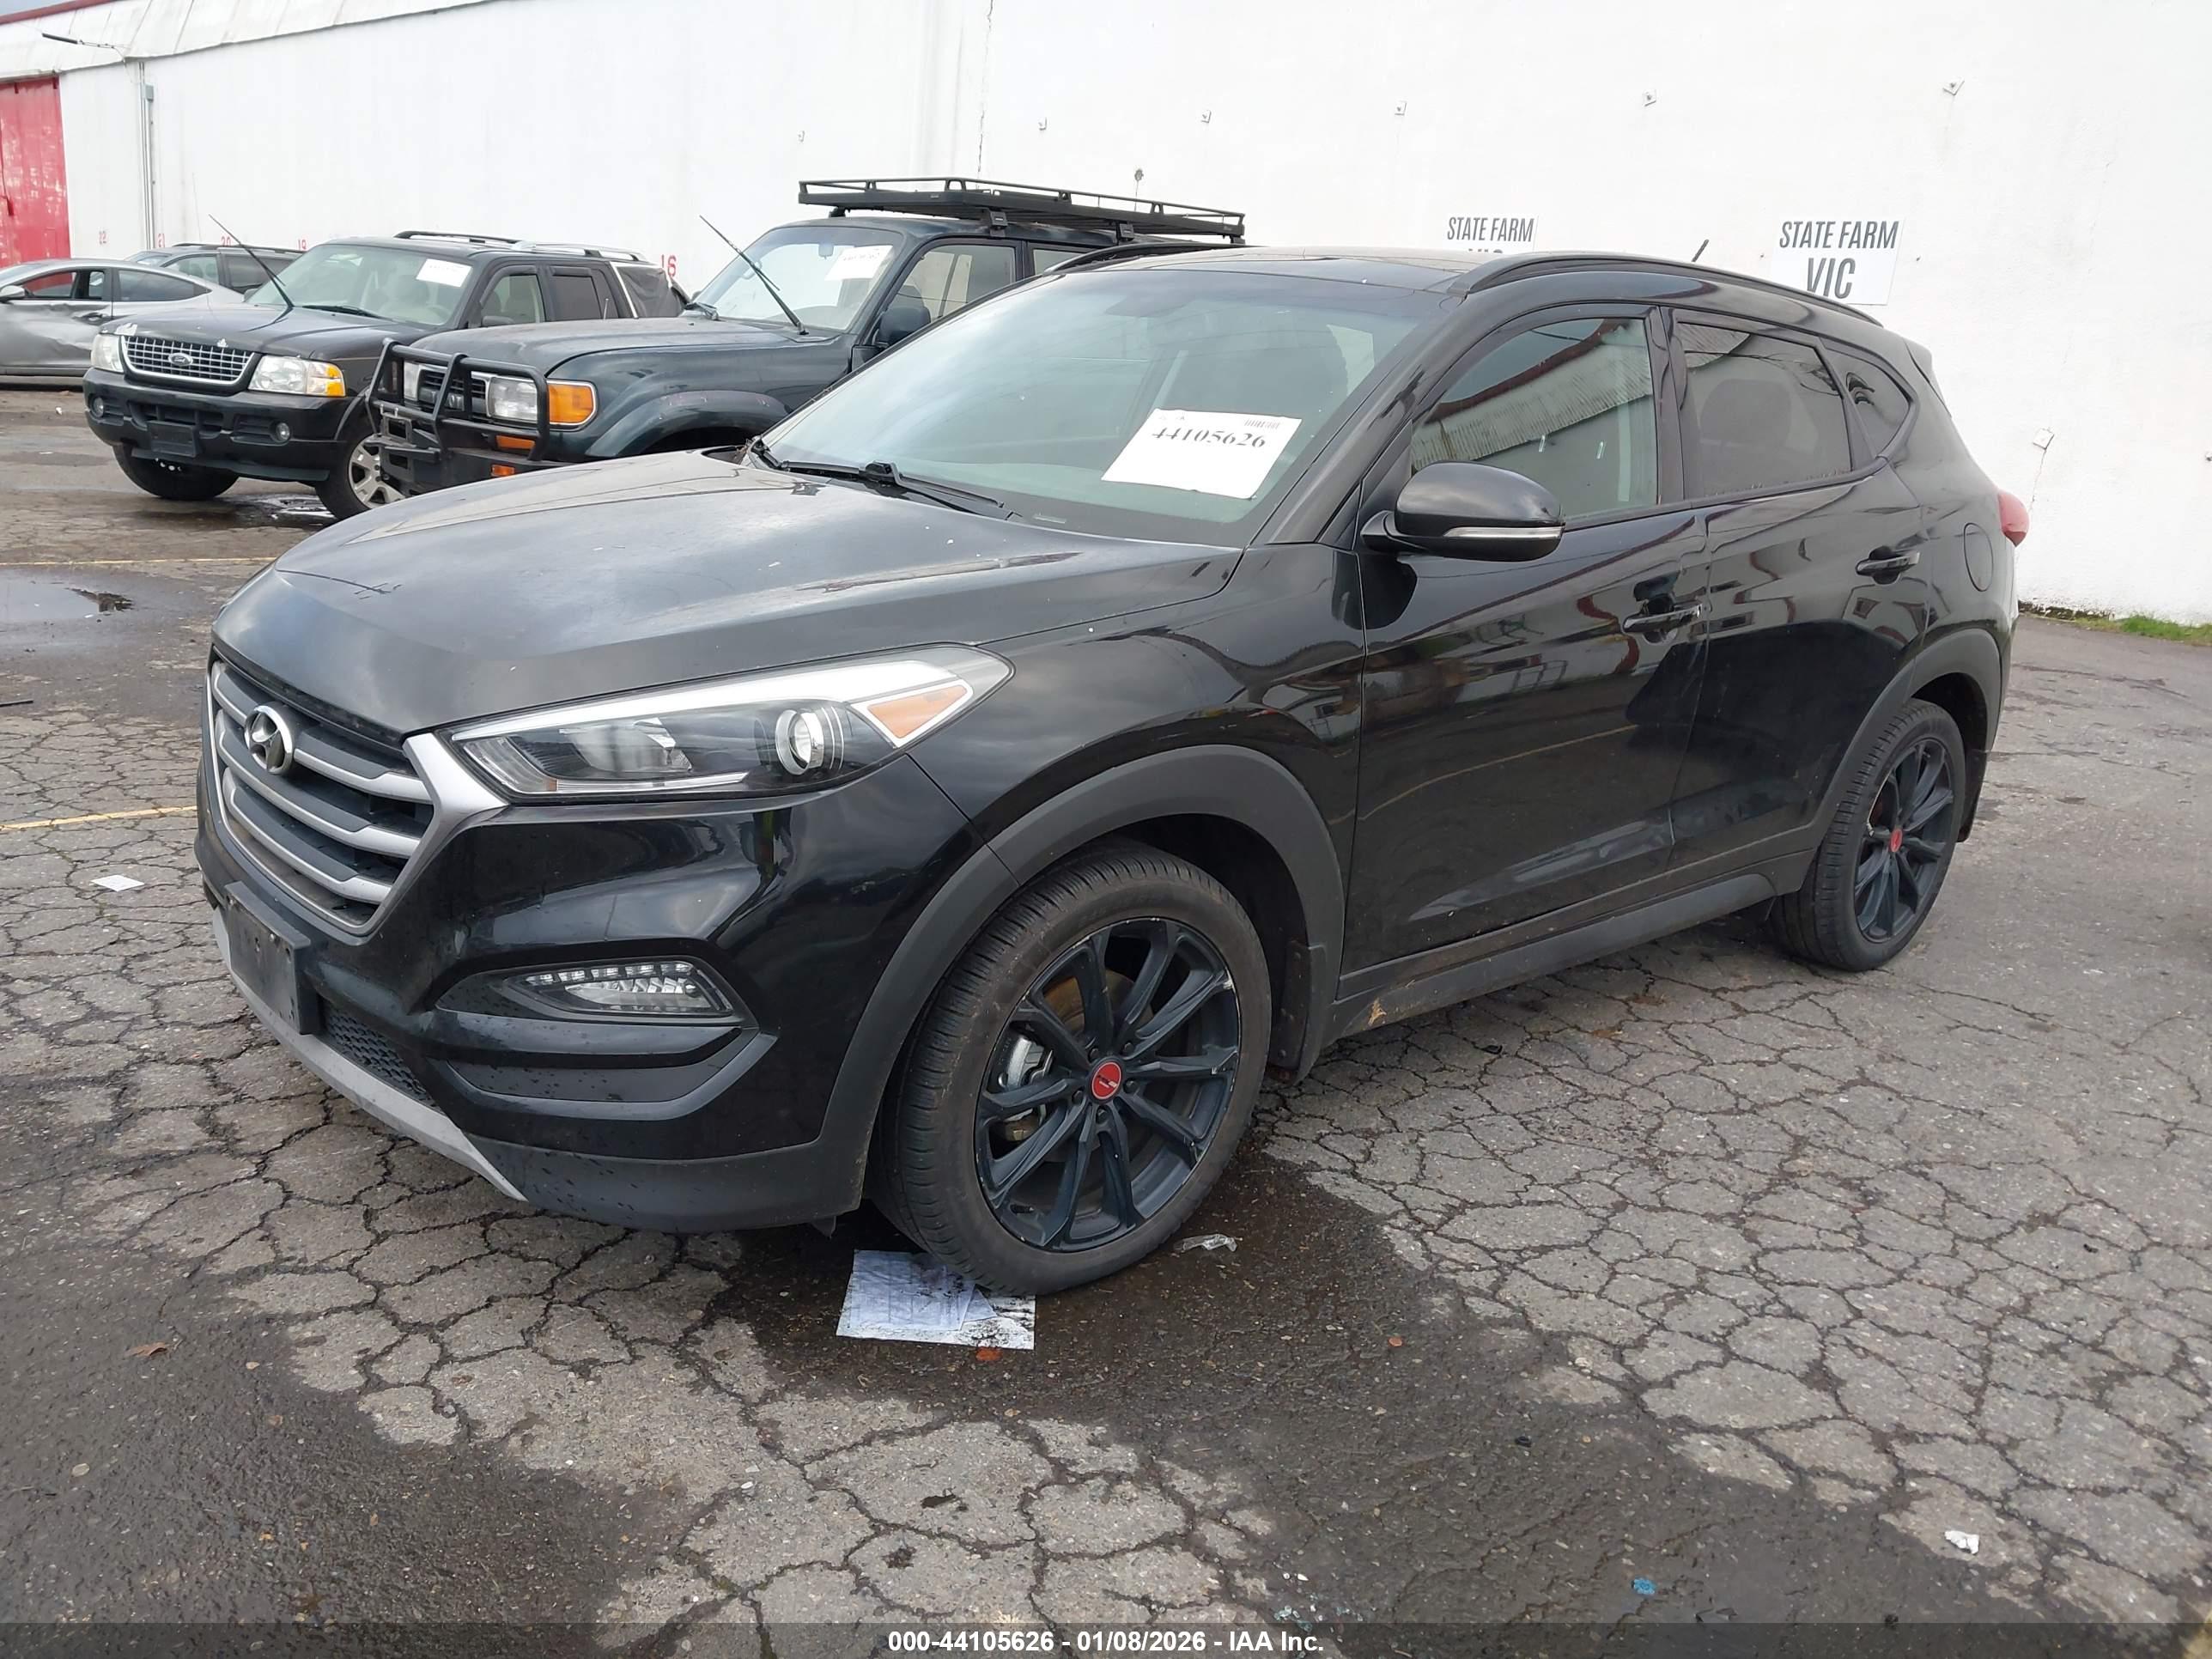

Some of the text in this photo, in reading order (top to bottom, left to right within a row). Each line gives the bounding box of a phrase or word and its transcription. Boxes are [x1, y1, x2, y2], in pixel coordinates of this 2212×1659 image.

[1447, 217, 1534, 242] STATE FARM
[1779, 221, 1899, 249] STATE FARM
[661, 254, 677, 276] 16
[1807, 258, 1856, 299] VIC
[1152, 428, 1266, 447] 44105626
